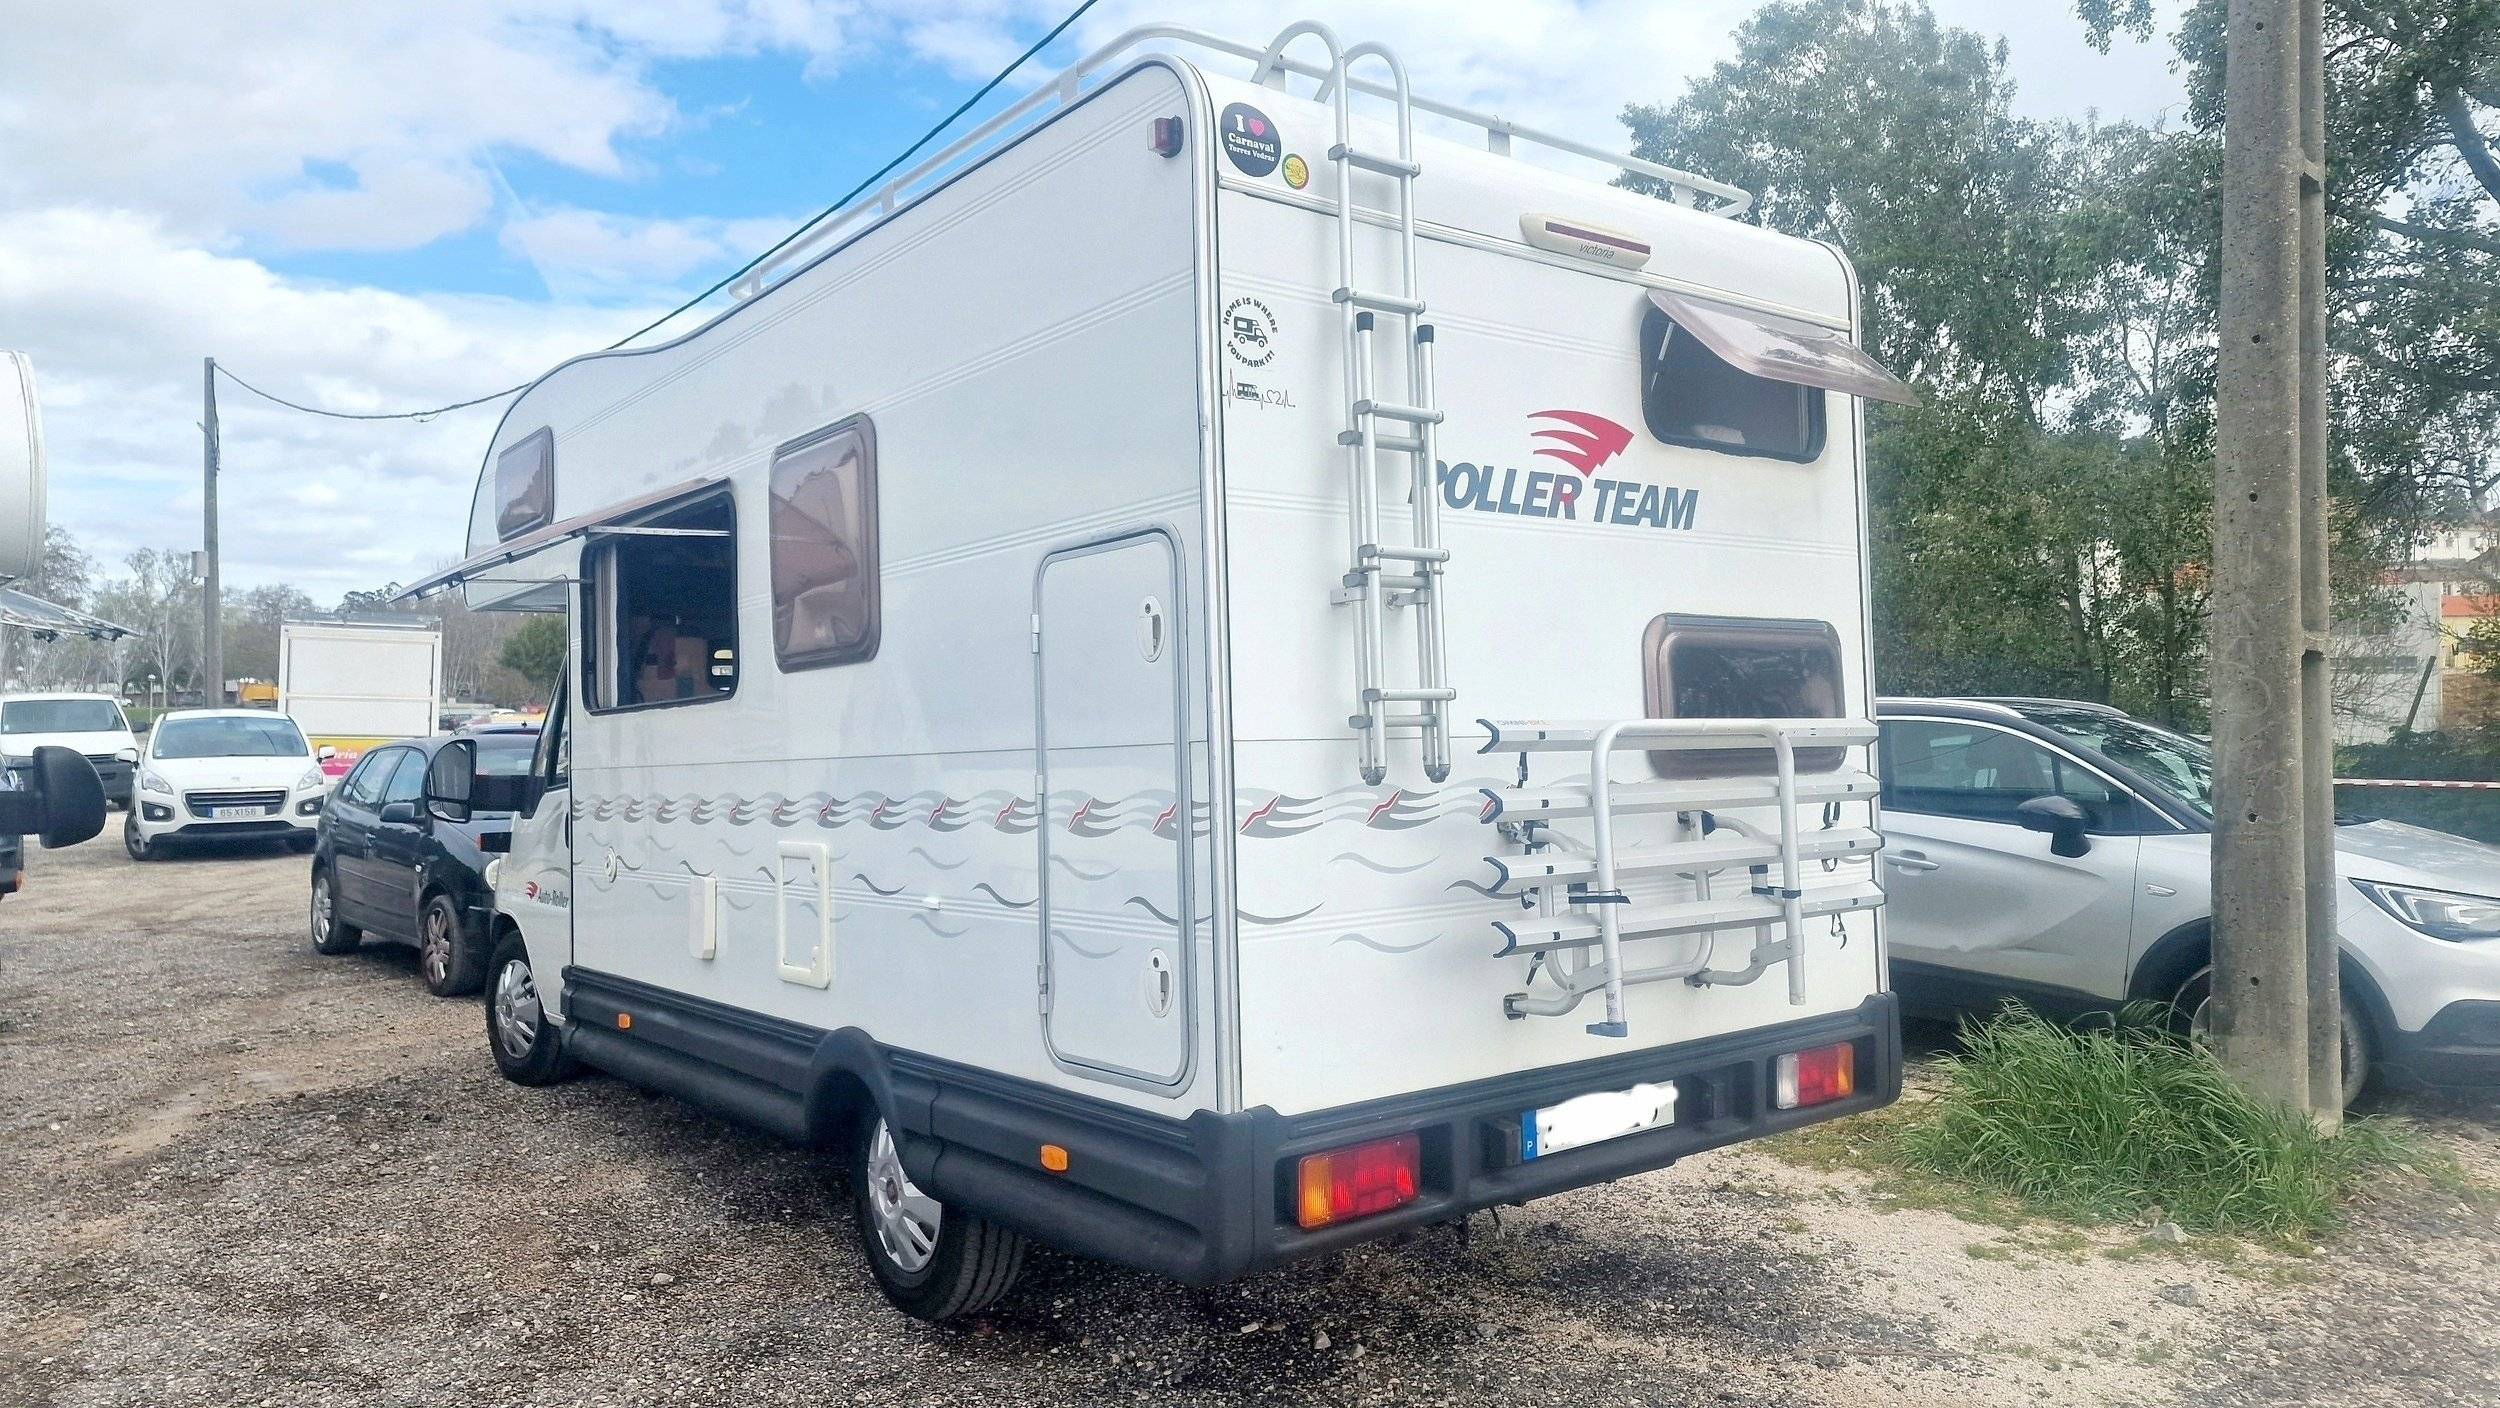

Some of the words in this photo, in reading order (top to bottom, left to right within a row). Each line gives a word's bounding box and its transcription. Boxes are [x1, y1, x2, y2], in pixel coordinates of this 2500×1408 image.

[1234, 114, 1245, 133] I
[1228, 132, 1275, 153] Carnaval
[1228, 144, 1251, 155] Torres
[1252, 149, 1275, 162] Vedras
[1579, 243, 1615, 259] victoria
[1223, 298, 1242, 325] HOME
[1242, 297, 1251, 305] IS
[1253, 299, 1279, 334] WHERE
[1226, 340, 1241, 360] YOU
[1241, 356, 1265, 368] PARK
[1264, 350, 1275, 363] IT!
[1593, 479, 1700, 530] TEAM
[1526, 1140, 1533, 1152] P
